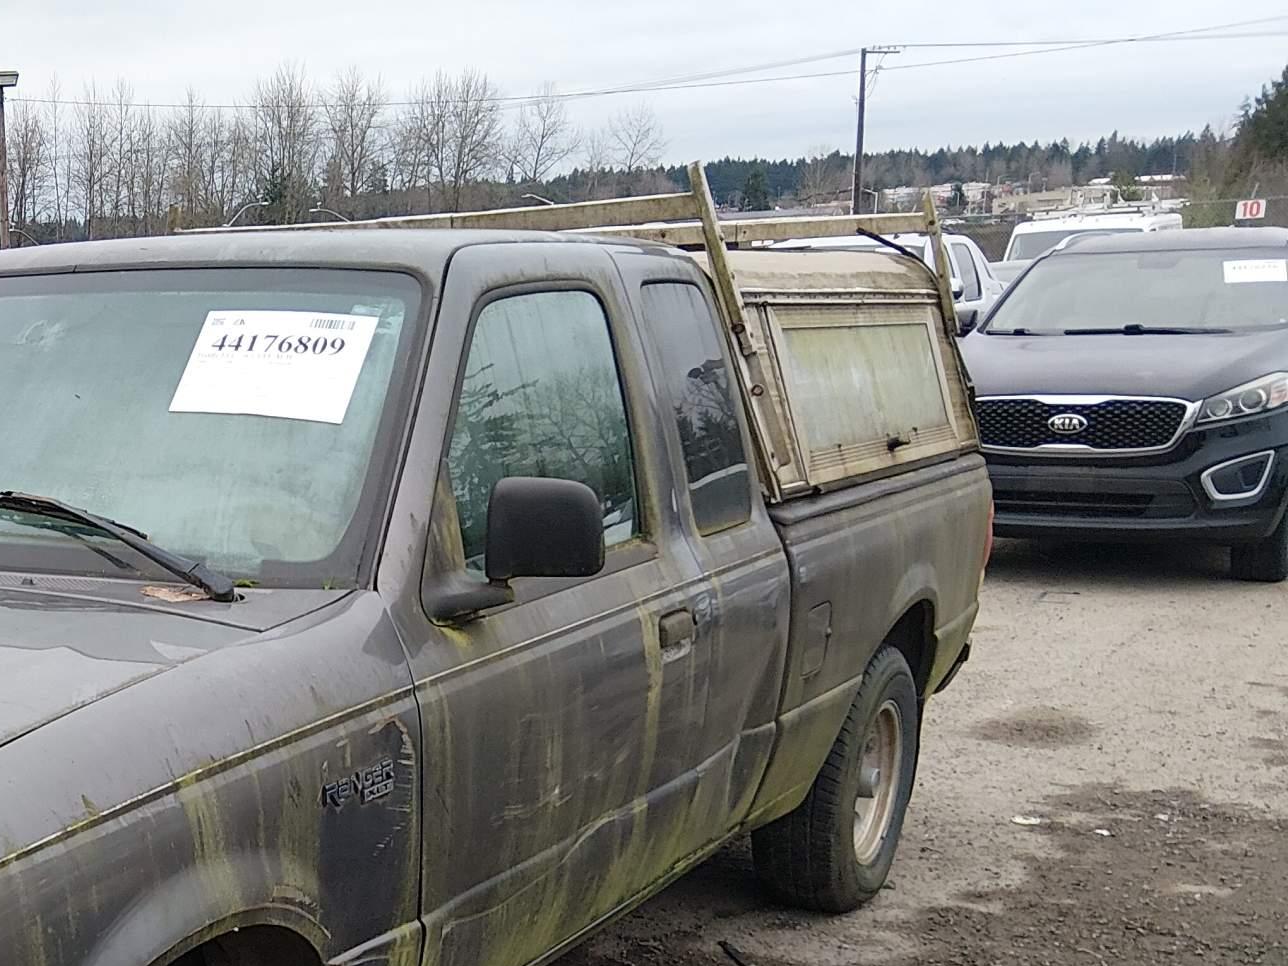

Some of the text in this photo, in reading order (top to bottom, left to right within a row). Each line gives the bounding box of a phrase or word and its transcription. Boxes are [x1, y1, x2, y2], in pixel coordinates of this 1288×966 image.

[1242, 201, 1261, 217] 10
[211, 333, 346, 356] 44176809
[1054, 418, 1080, 430] KIA
